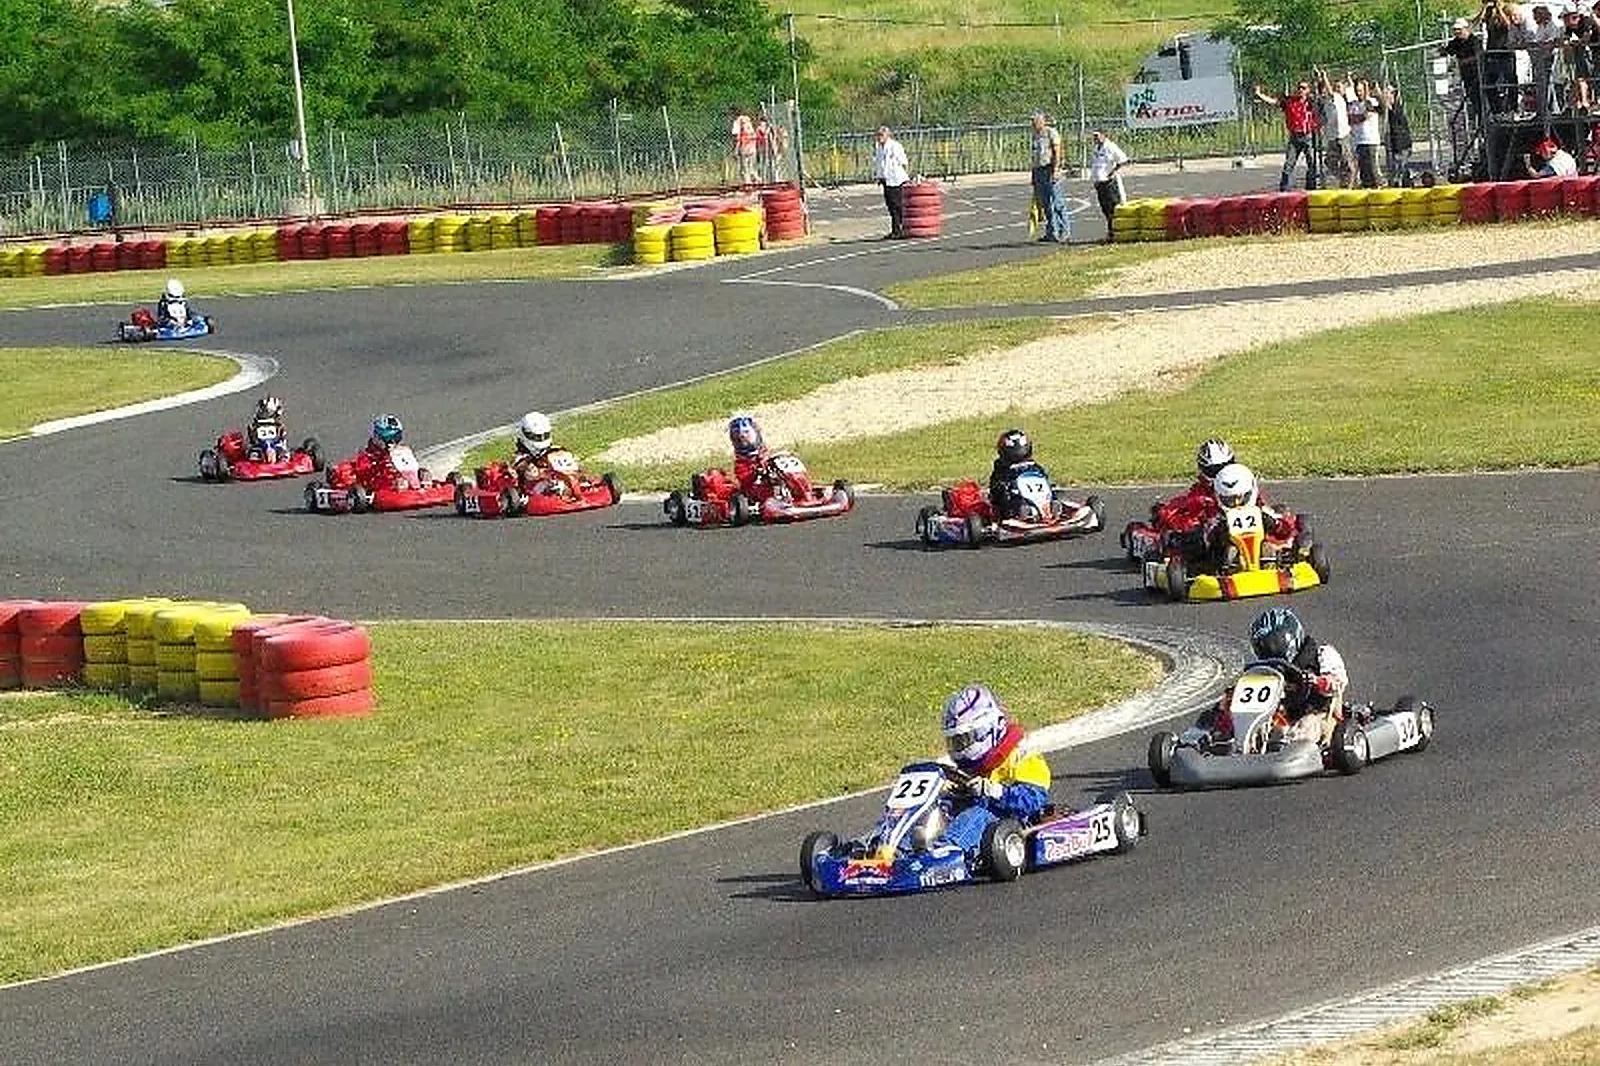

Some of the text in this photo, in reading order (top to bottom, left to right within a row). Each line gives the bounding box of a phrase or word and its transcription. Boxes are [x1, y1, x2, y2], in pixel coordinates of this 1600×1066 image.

[1232, 515, 1257, 529] 42
[1239, 685, 1271, 703] 30
[895, 779, 929, 799] 25
[1092, 816, 1111, 843] 25
